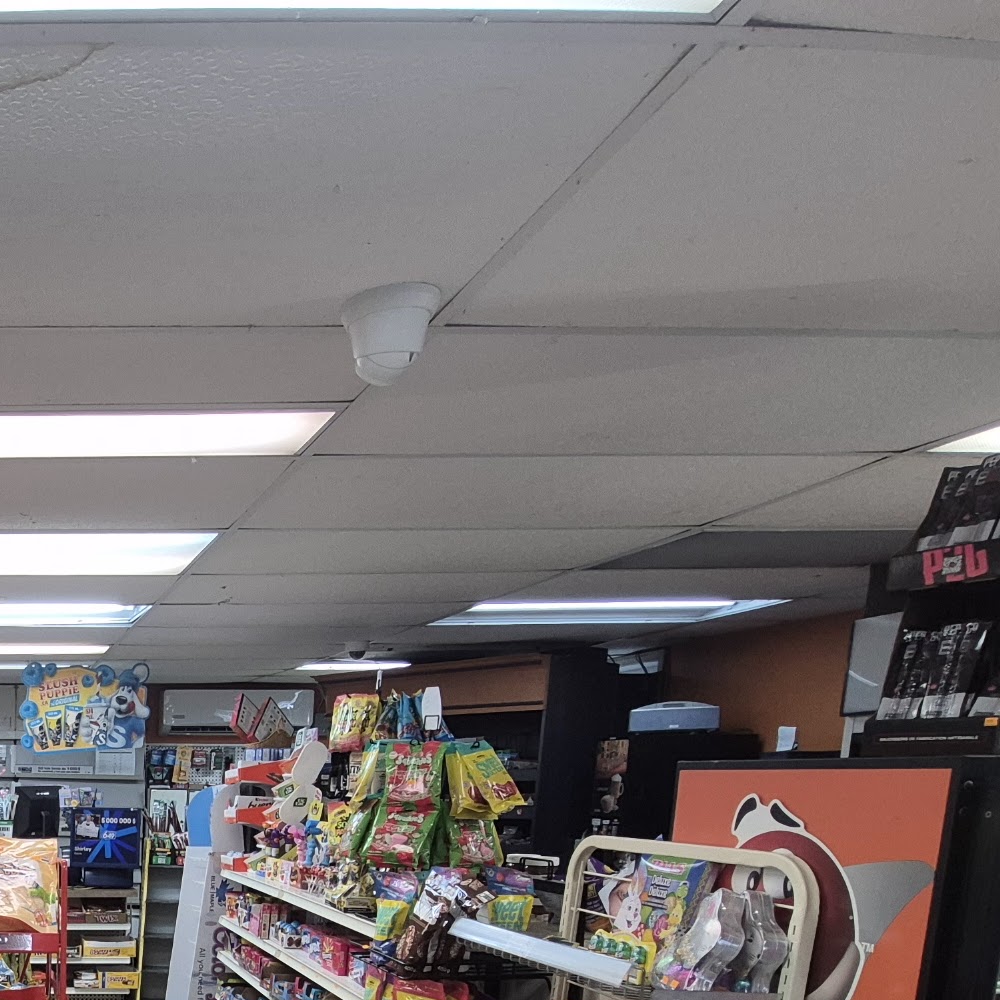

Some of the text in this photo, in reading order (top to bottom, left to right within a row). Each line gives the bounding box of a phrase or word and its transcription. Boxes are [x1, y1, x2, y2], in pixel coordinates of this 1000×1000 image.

[39, 677, 78, 692] SLUSH
[40, 688, 79, 700] PUPPIE
[107, 725, 127, 748] S
